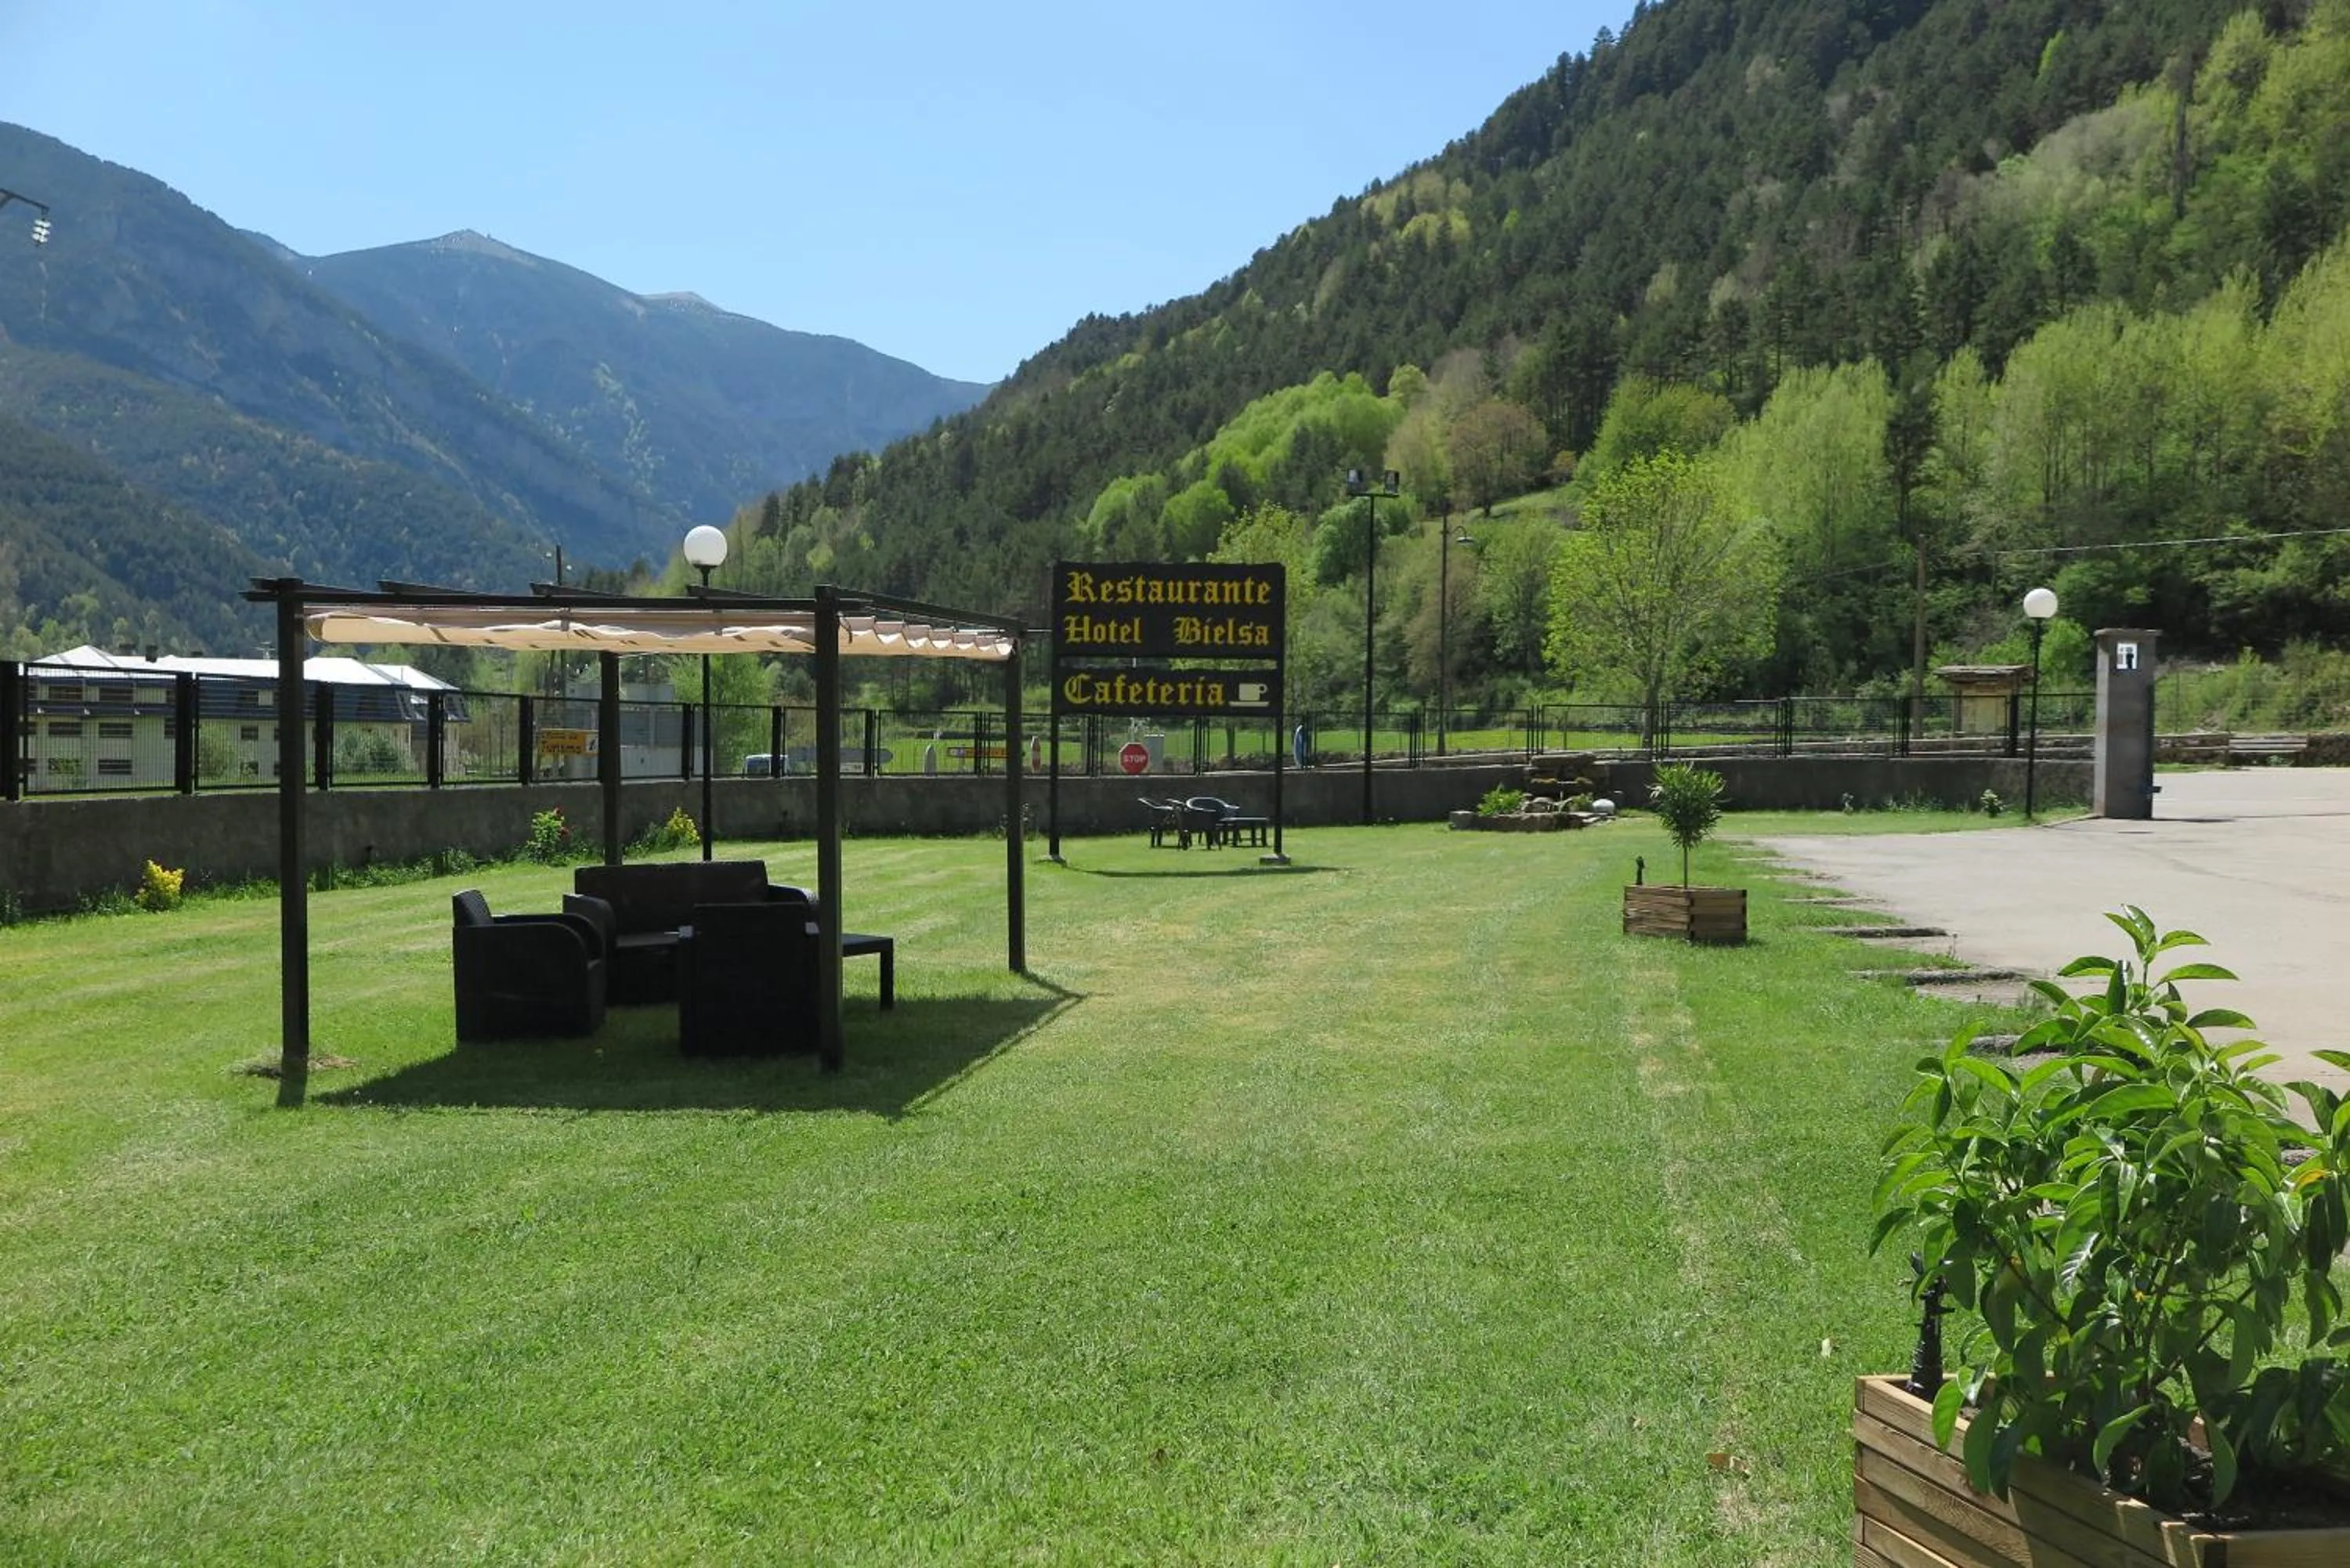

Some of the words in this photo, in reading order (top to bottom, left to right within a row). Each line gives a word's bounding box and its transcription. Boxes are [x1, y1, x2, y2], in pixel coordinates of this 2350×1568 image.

[1065, 571, 1271, 604] Restaurante
[1064, 615, 1142, 644] Hotel
[1124, 754, 1147, 764] STOP
